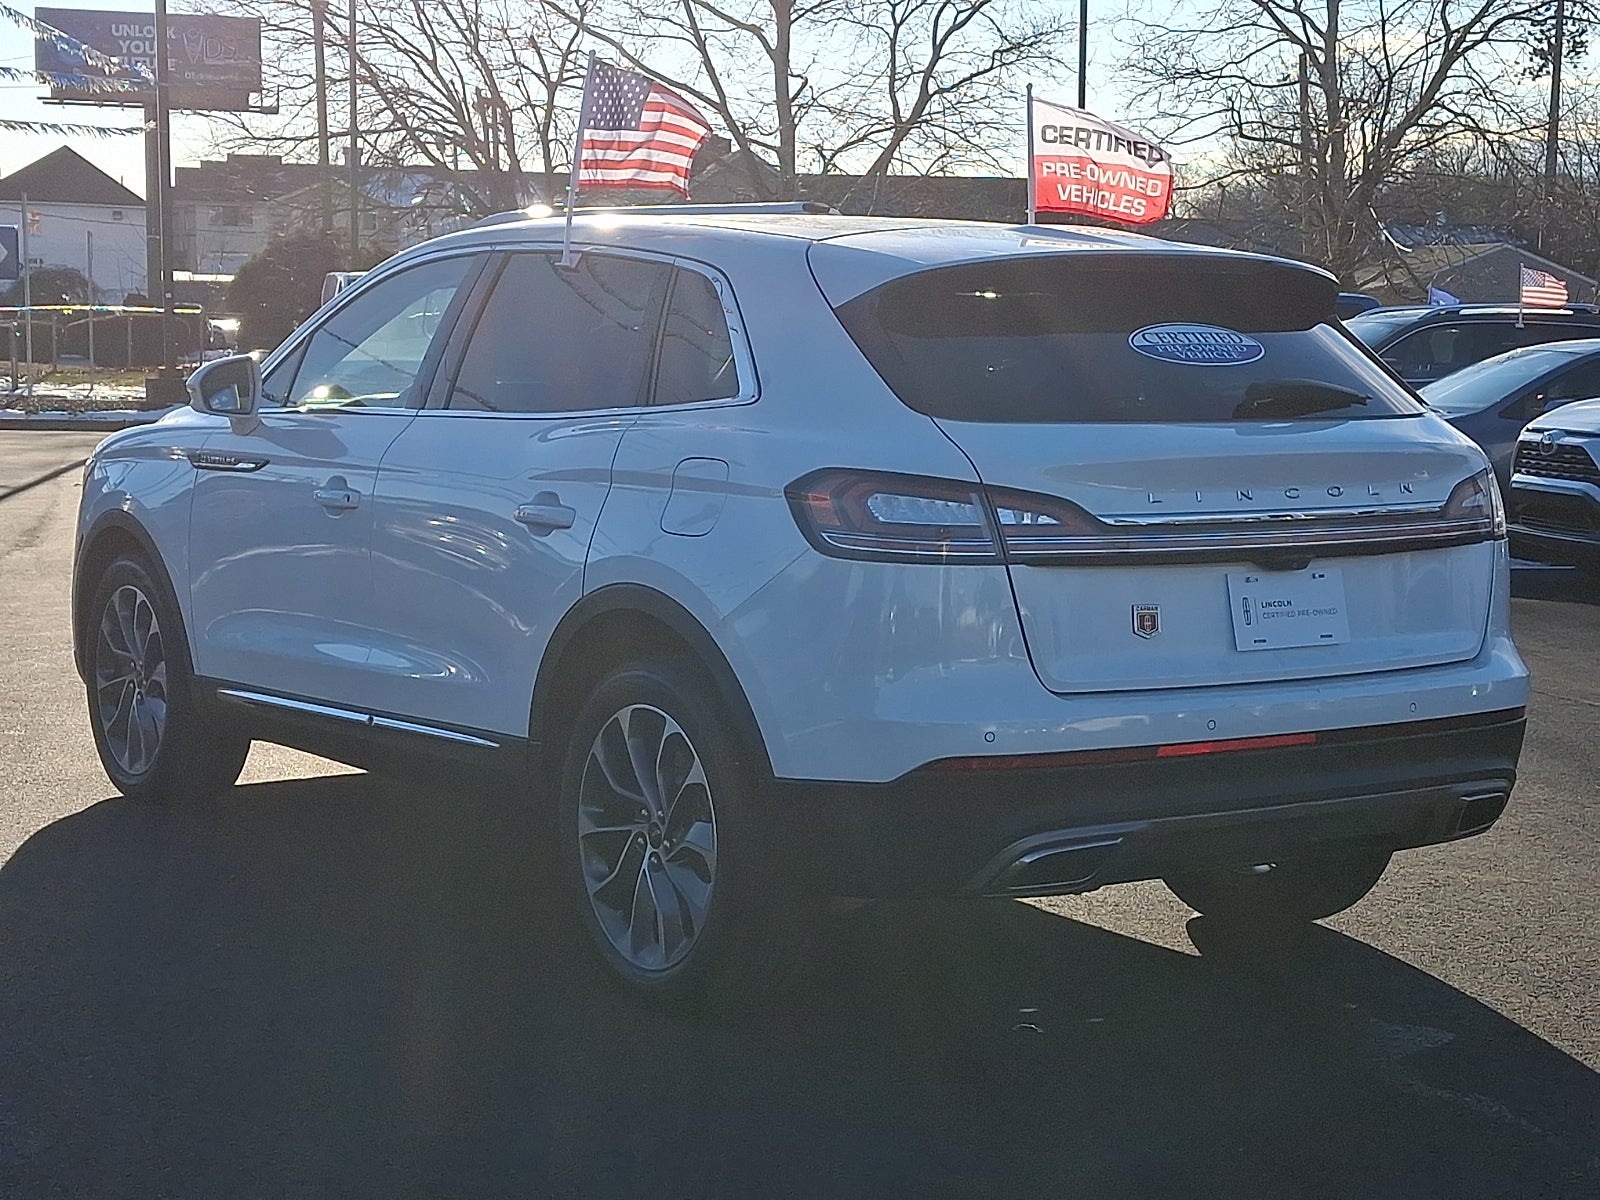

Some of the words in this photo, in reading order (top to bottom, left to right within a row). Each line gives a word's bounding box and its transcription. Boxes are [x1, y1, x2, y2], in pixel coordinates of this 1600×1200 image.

[111, 24, 176, 39] UNLOK
[119, 40, 170, 57] YOU
[1041, 124, 1164, 163] CERTIFIED
[1042, 162, 1162, 197] PRE-OWNED
[1056, 184, 1147, 216] VEHICLES
[1141, 331, 1244, 345] CERTIFIED
[1175, 350, 1243, 360] VEHICLE
[1148, 482, 1414, 504] LINCOLN
[1261, 600, 1292, 608] LINCOLN
[1262, 610, 1296, 620] CERTIFIED
[1297, 607, 1338, 617] PRE-OWNED
